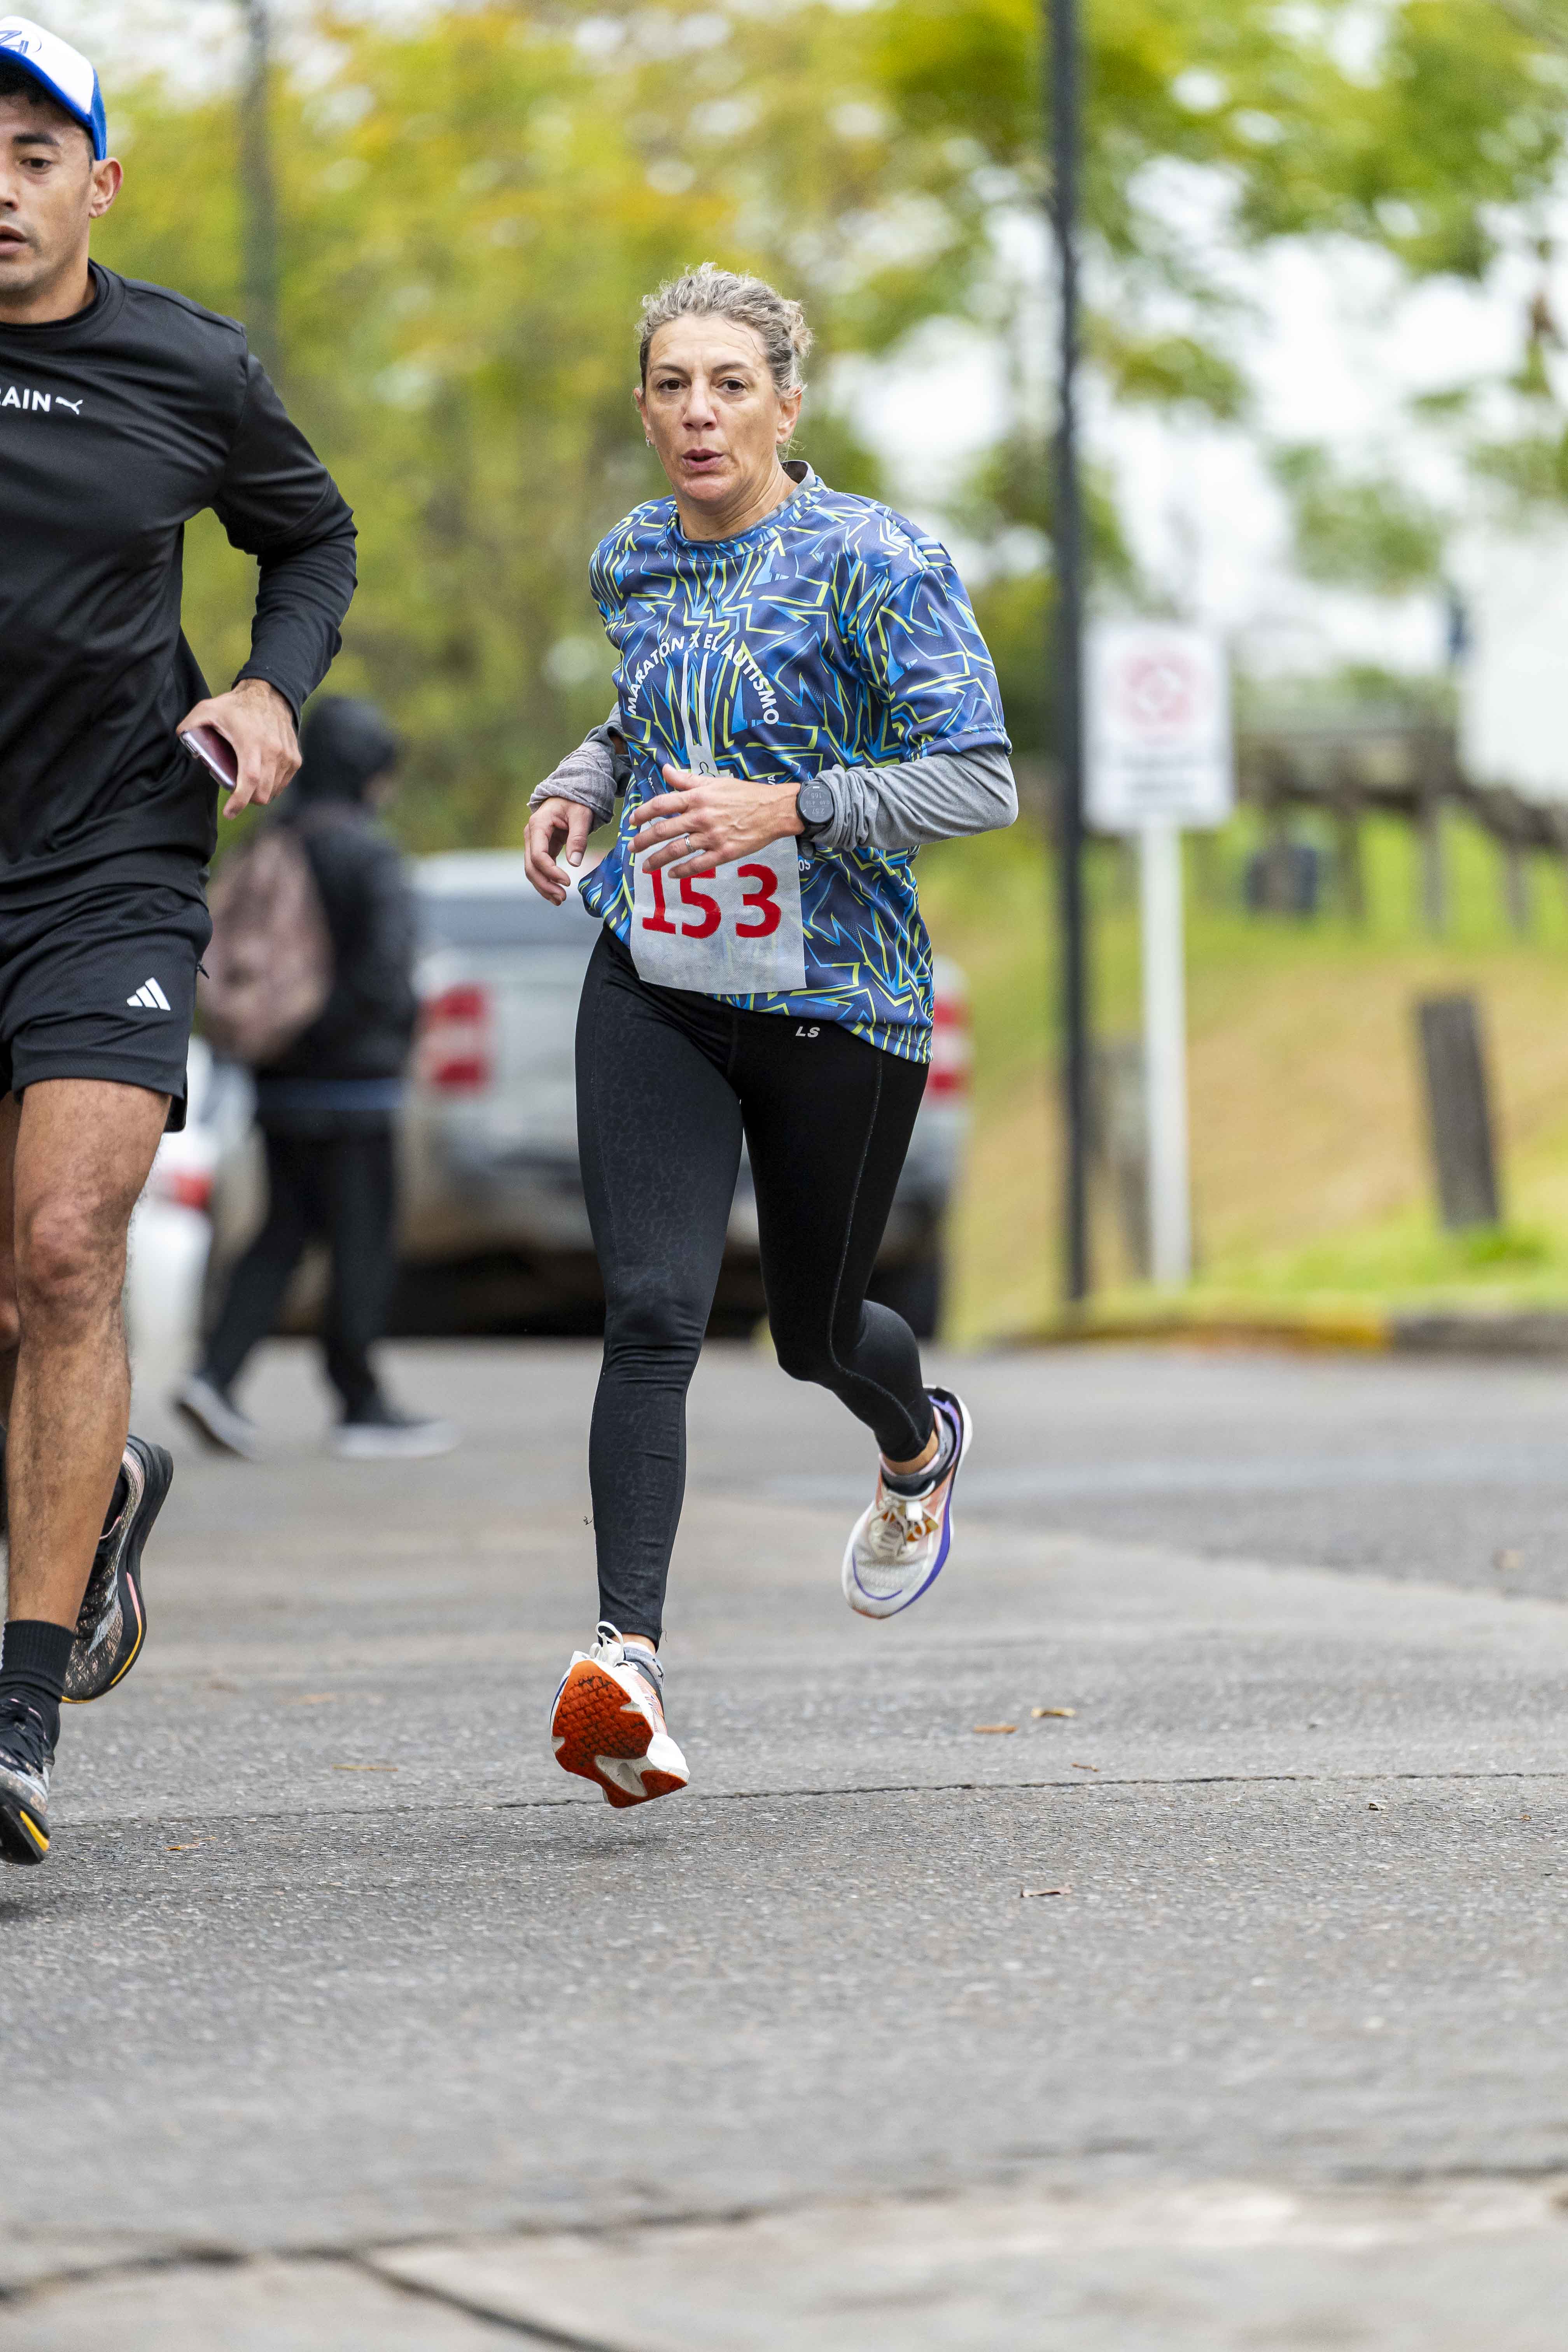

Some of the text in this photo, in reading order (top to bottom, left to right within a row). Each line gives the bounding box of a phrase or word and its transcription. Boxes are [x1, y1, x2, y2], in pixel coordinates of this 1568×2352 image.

[0, 386, 51, 412] AIN
[628, 633, 779, 725] MARATÓN X EL AUTISMO
[642, 863, 782, 938] 153
[795, 1026, 820, 1038] LS
